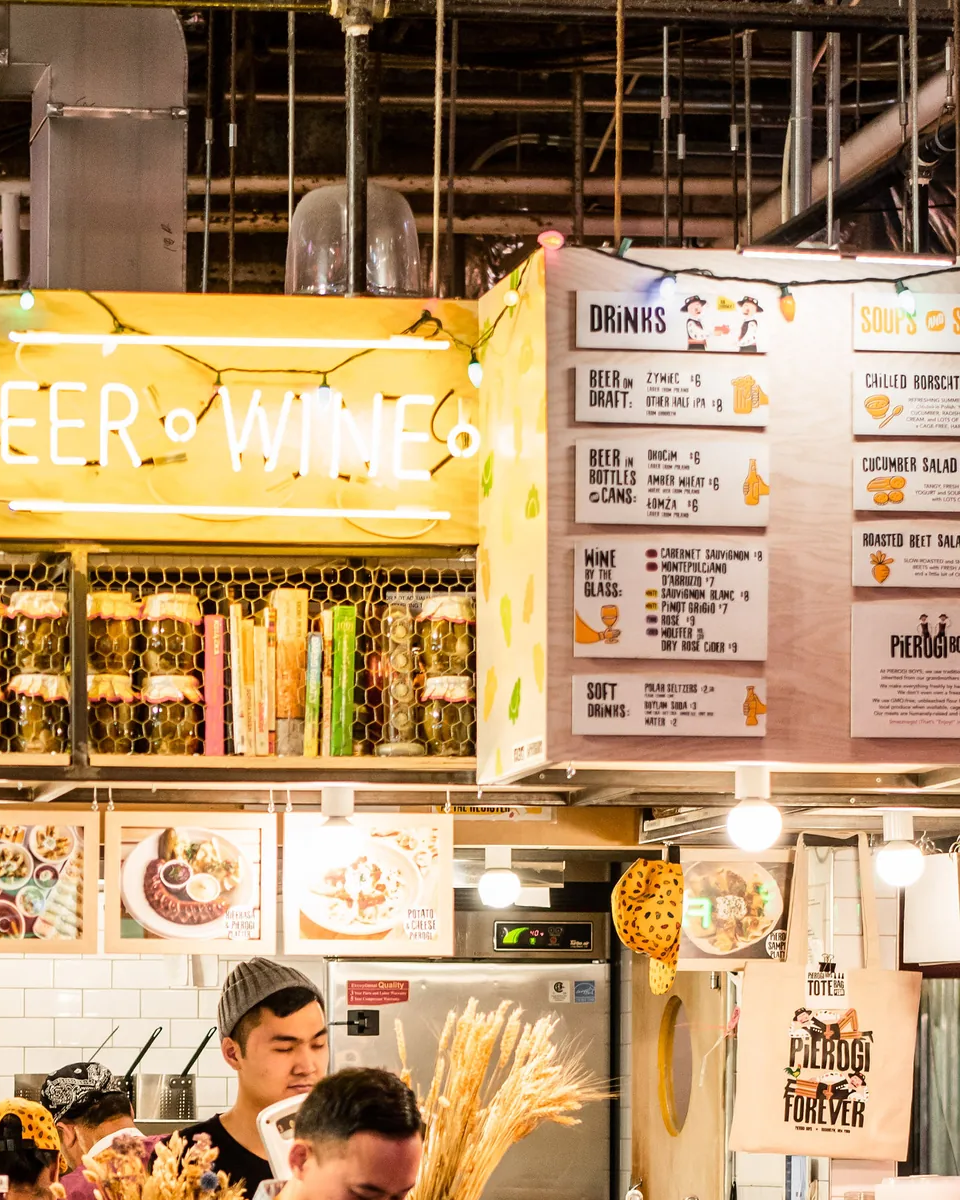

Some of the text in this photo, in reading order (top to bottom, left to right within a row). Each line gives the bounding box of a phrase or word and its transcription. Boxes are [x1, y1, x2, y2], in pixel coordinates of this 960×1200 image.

[589, 369, 633, 389] BEER ON
[913, 374, 960, 390] BORSCHT
[589, 390, 633, 409] DRAFT:
[645, 395, 671, 408] OTHER
[672, 396, 689, 408] HALF
[218, 386, 436, 481] WINE
[589, 449, 620, 468] BEER
[862, 456, 958, 474] CUCUMBER SALAD
[589, 469, 637, 486] BOTTLES
[647, 474, 675, 486] AMBER
[679, 475, 705, 488] WHEAT
[601, 487, 637, 505] CANS:
[862, 533, 903, 548] ROASTED
[909, 534, 932, 548] BEET
[660, 548, 702, 560] CABERNET
[585, 569, 612, 581] BY THE
[584, 581, 623, 598] GLASS:
[710, 590, 735, 601] BLANC
[661, 640, 677, 652] DRY
[587, 682, 618, 701] SOFT
[644, 683, 698, 693] POLAR SELTZERS
[671, 702, 688, 710] SODA
[644, 717, 666, 727] WATER
[407, 908, 434, 919] POTATO
[411, 920, 436, 930] CHEESE
[378, 981, 405, 989] Quality
[807, 980, 833, 996] TOTE
[834, 980, 844, 988] BAG
[783, 1094, 866, 1128] FOREVER
